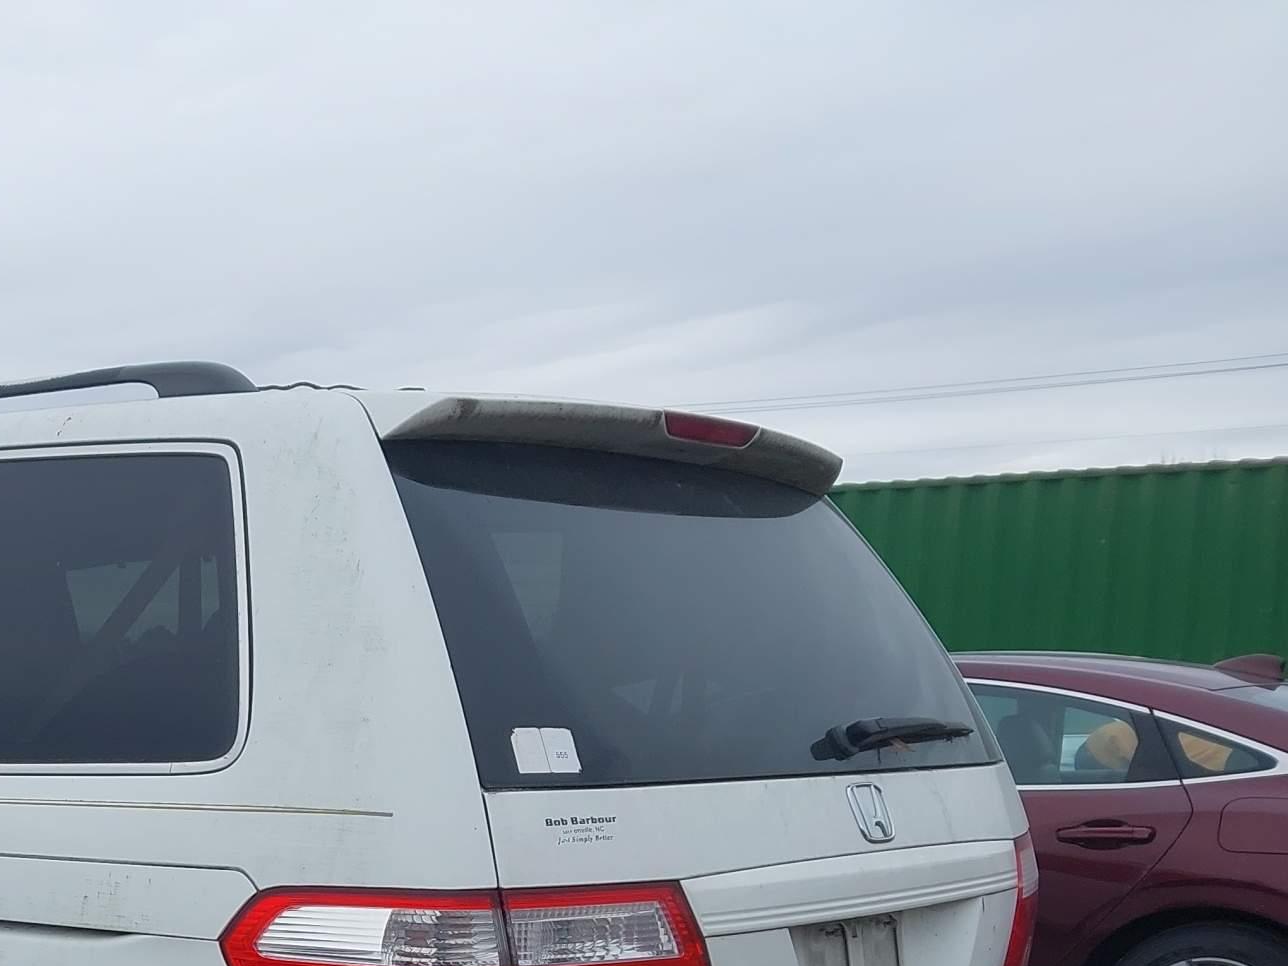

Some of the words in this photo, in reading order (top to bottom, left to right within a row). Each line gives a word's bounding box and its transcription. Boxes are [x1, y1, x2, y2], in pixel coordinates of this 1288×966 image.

[545, 817, 568, 827] Bob
[570, 816, 617, 825] Barbour
[571, 835, 593, 844] Simply
